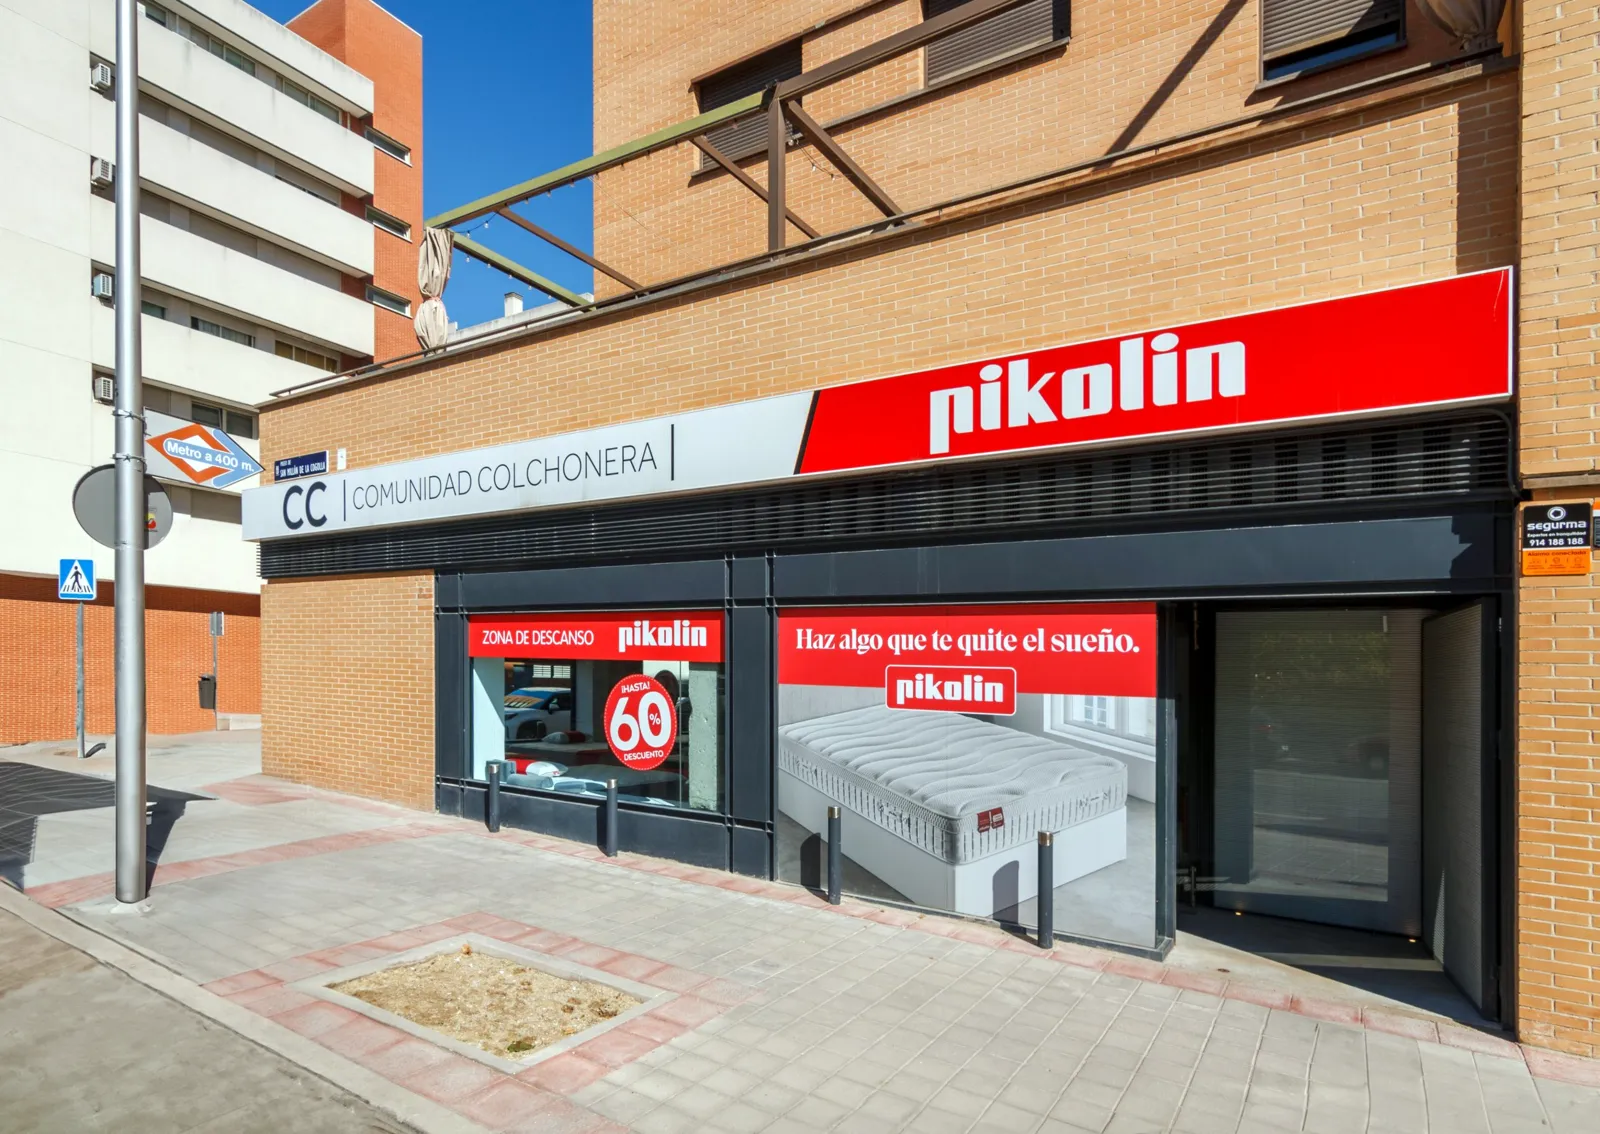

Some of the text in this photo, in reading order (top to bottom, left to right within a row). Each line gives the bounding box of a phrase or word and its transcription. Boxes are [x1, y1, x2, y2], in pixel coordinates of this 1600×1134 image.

[930, 332, 1246, 455] pikolin
[167, 441, 255, 473] Metro a 400 m.
[299, 465, 304, 474] DE
[304, 464, 310, 473] LA
[352, 442, 657, 510] COMUNIDAD COLCHONERA
[283, 481, 328, 530] CC
[1527, 521, 1586, 531] segurma
[482, 630, 594, 646] ZONA DE DESCANSO
[618, 620, 707, 652] pikolin
[796, 628, 1140, 656] Haz algo que te quite el sueño.
[621, 681, 650, 693] ¡HASTA!
[896, 673, 1004, 705] pikolin
[624, 750, 664, 761] DESCUENTO
